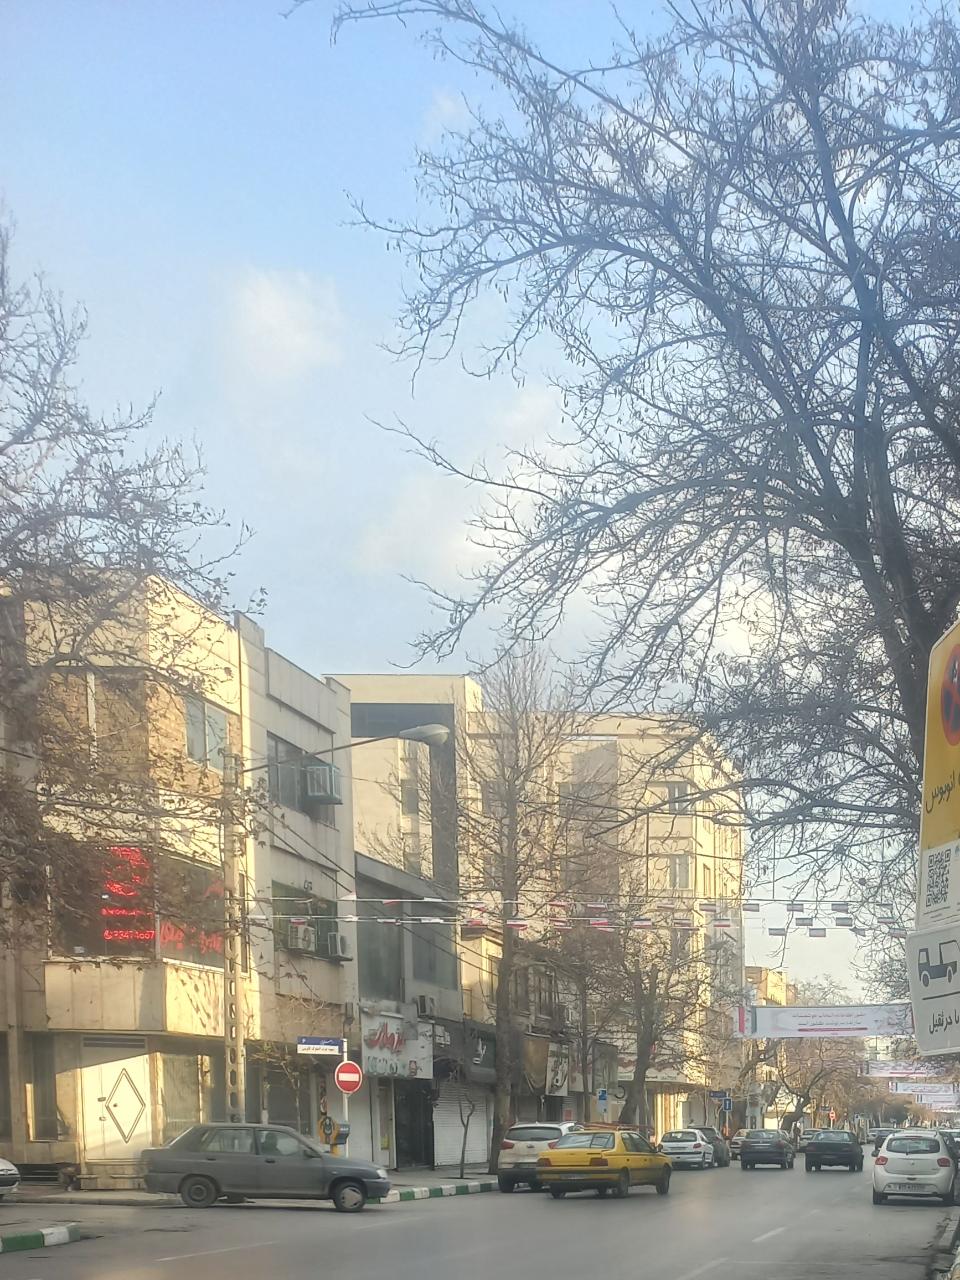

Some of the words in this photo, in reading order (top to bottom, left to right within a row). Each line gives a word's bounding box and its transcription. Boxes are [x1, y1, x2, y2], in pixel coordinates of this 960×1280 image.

[925, 769, 956, 814] اتوبوس
[928, 1010, 953, 1035] جرثقیل
[954, 1009, 960, 1025] با
